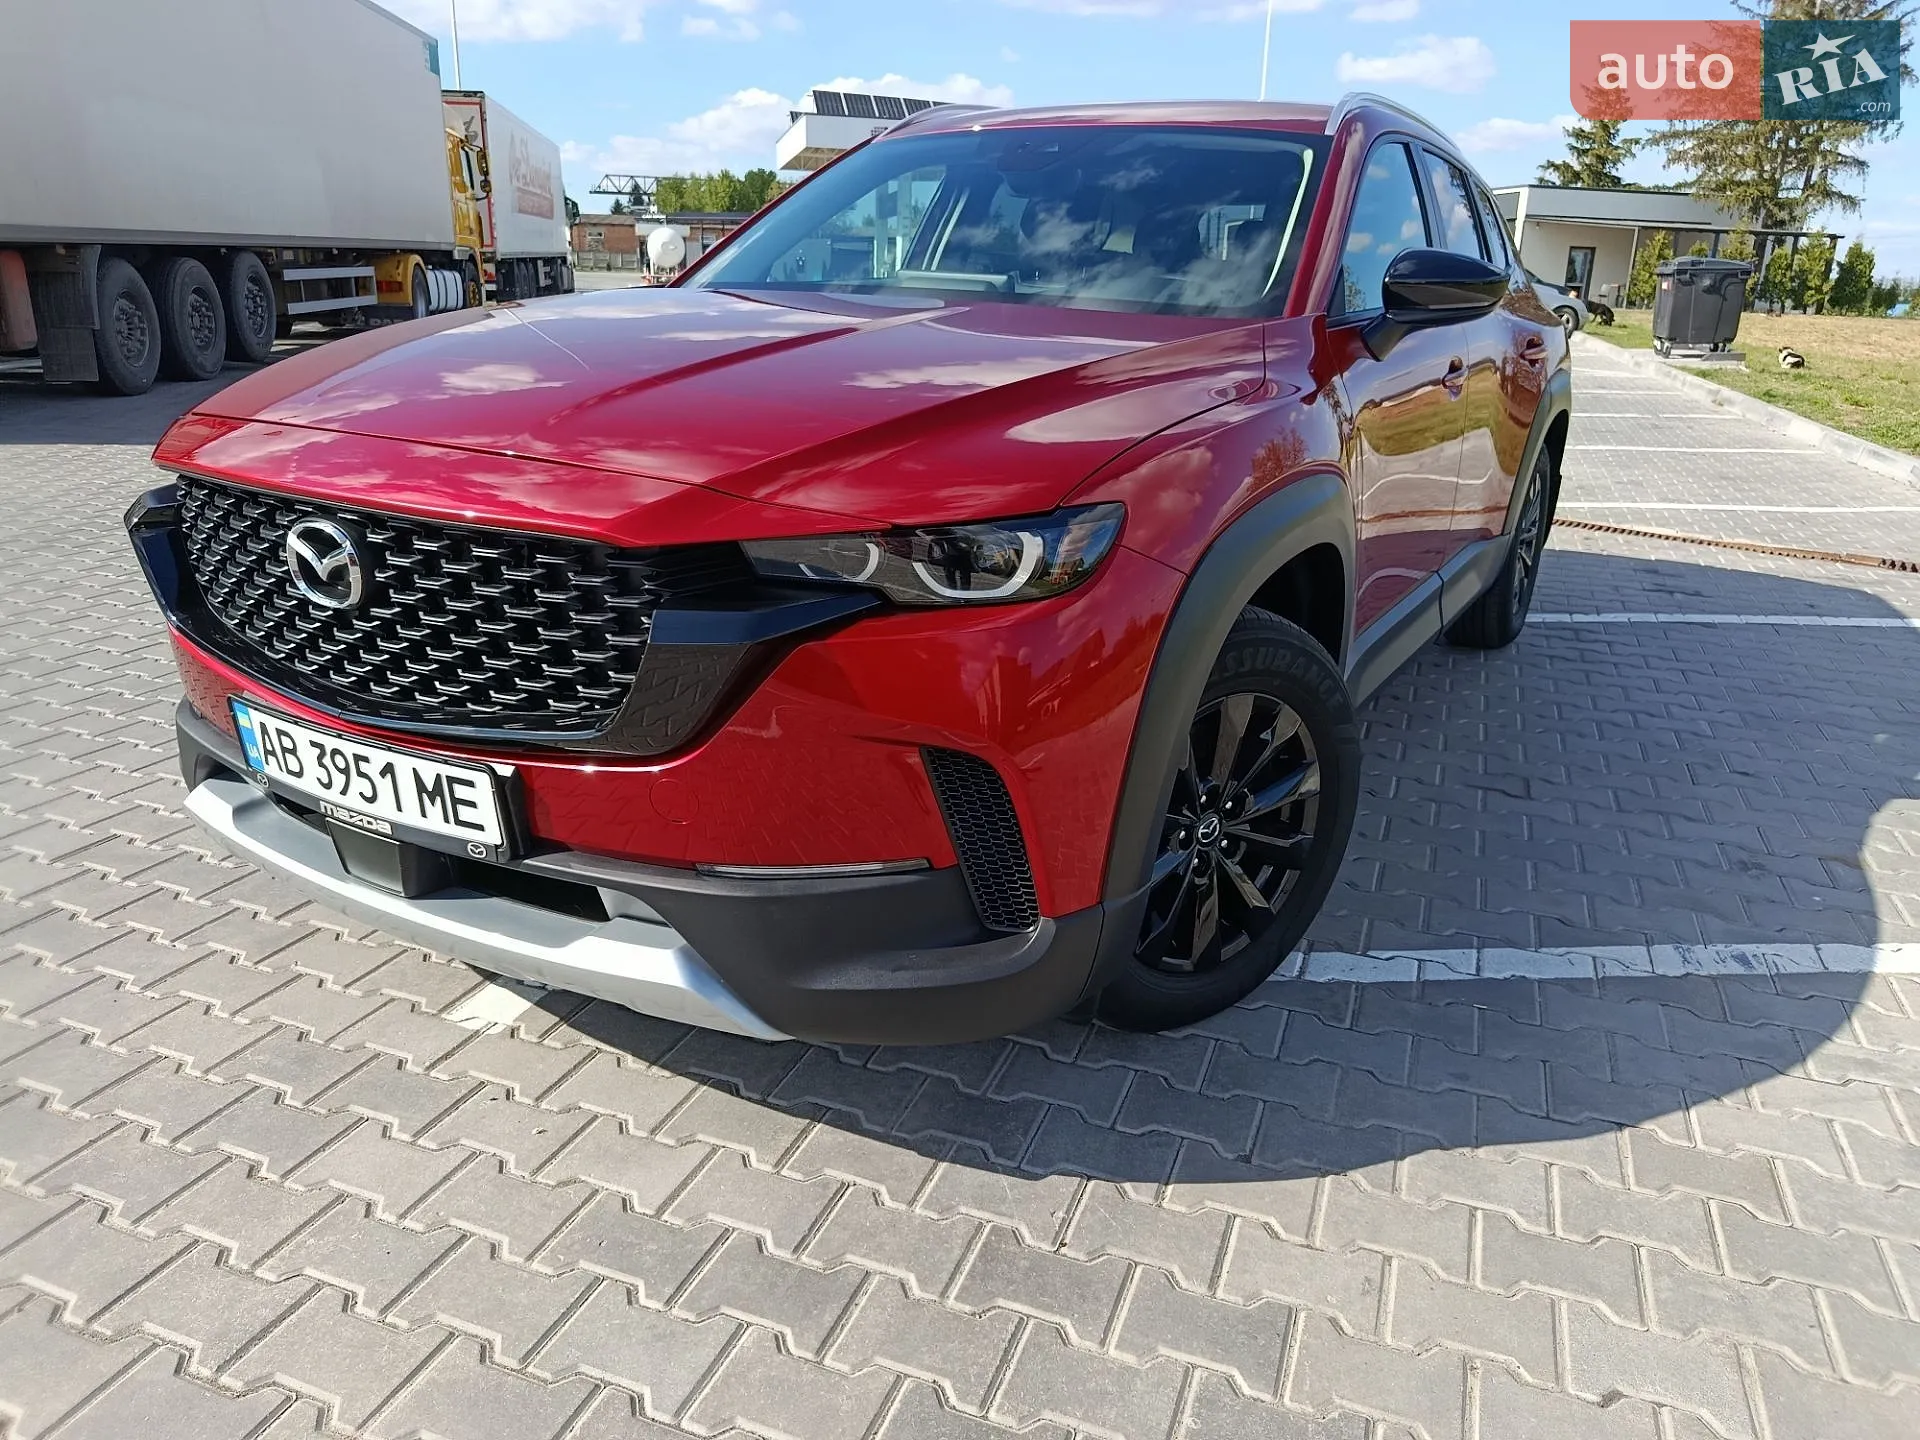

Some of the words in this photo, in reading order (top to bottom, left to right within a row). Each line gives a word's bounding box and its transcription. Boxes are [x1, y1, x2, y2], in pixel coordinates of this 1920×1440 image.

[259, 721, 304, 779] AB
[308, 739, 403, 813] 3951
[412, 767, 486, 833] ME
